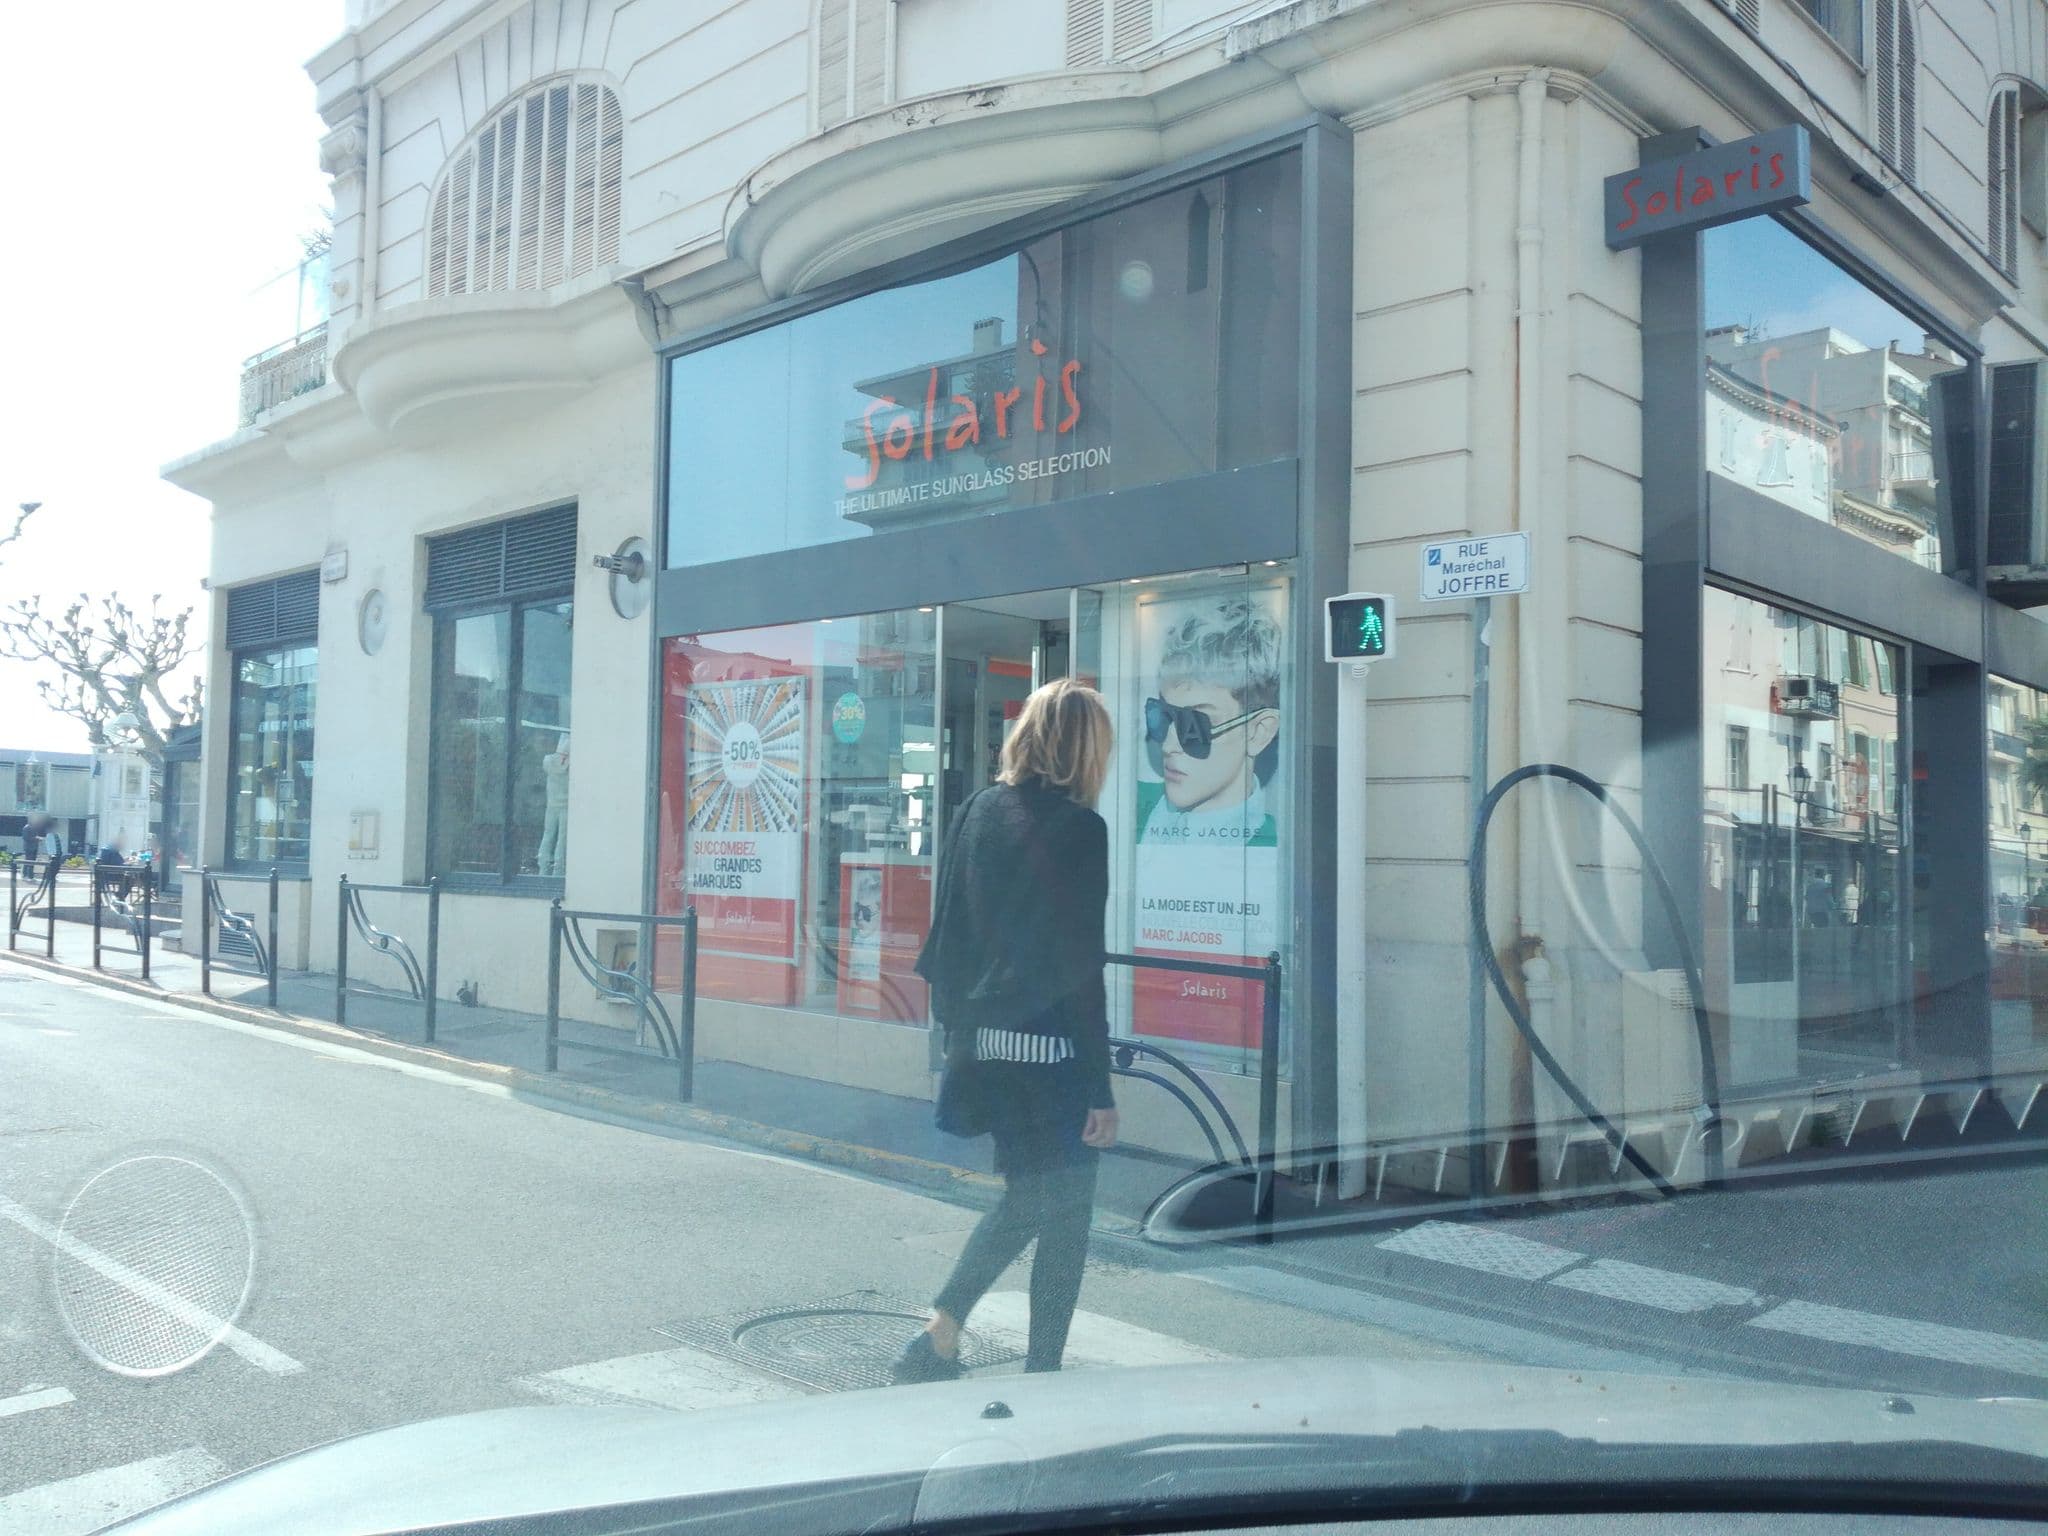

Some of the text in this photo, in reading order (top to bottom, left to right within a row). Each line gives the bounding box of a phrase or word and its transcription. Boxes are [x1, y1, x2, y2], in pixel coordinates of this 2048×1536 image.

[1615, 146, 1786, 231] Solaris
[844, 338, 1081, 490] Solaris
[834, 446, 1113, 517] THE ULTIMATE SUNGLASS SELECTION
[1459, 542, 1489, 558] RUE
[1442, 556, 1506, 575] Maréchal
[1438, 573, 1510, 594] JOFFRE
[724, 741, 760, 761] -50%
[1150, 826, 1262, 838] MARC JACOBS
[694, 840, 756, 856] SUCCOMBEZ
[714, 858, 762, 873] GRANDES
[693, 873, 742, 889] MARQUES
[1142, 898, 1260, 916] LA MODE EST UN JEU
[1142, 927, 1222, 945] MARC JACOBS
[1181, 979, 1227, 999] Solaris
